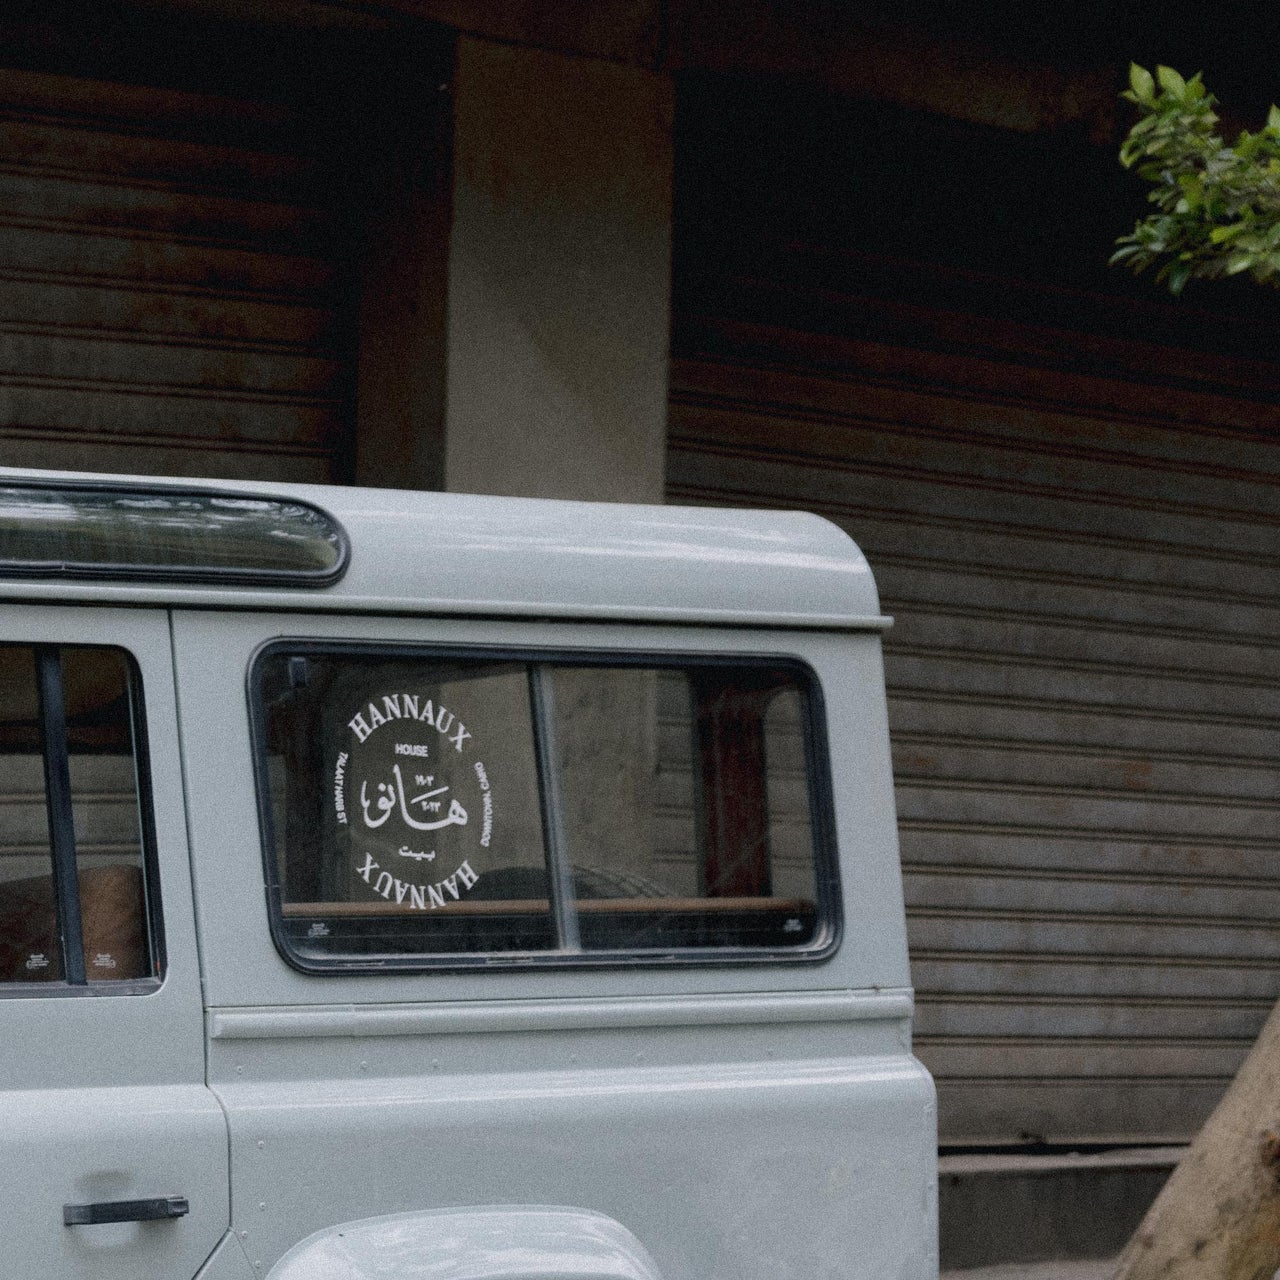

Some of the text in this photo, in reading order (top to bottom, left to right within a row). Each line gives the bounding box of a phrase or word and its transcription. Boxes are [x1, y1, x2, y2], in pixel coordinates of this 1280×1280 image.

[348, 693, 472, 753] HANNAUX
[395, 743, 429, 757] HOUSE
[398, 846, 436, 861] بيت
[356, 852, 479, 910] HANNAUX
